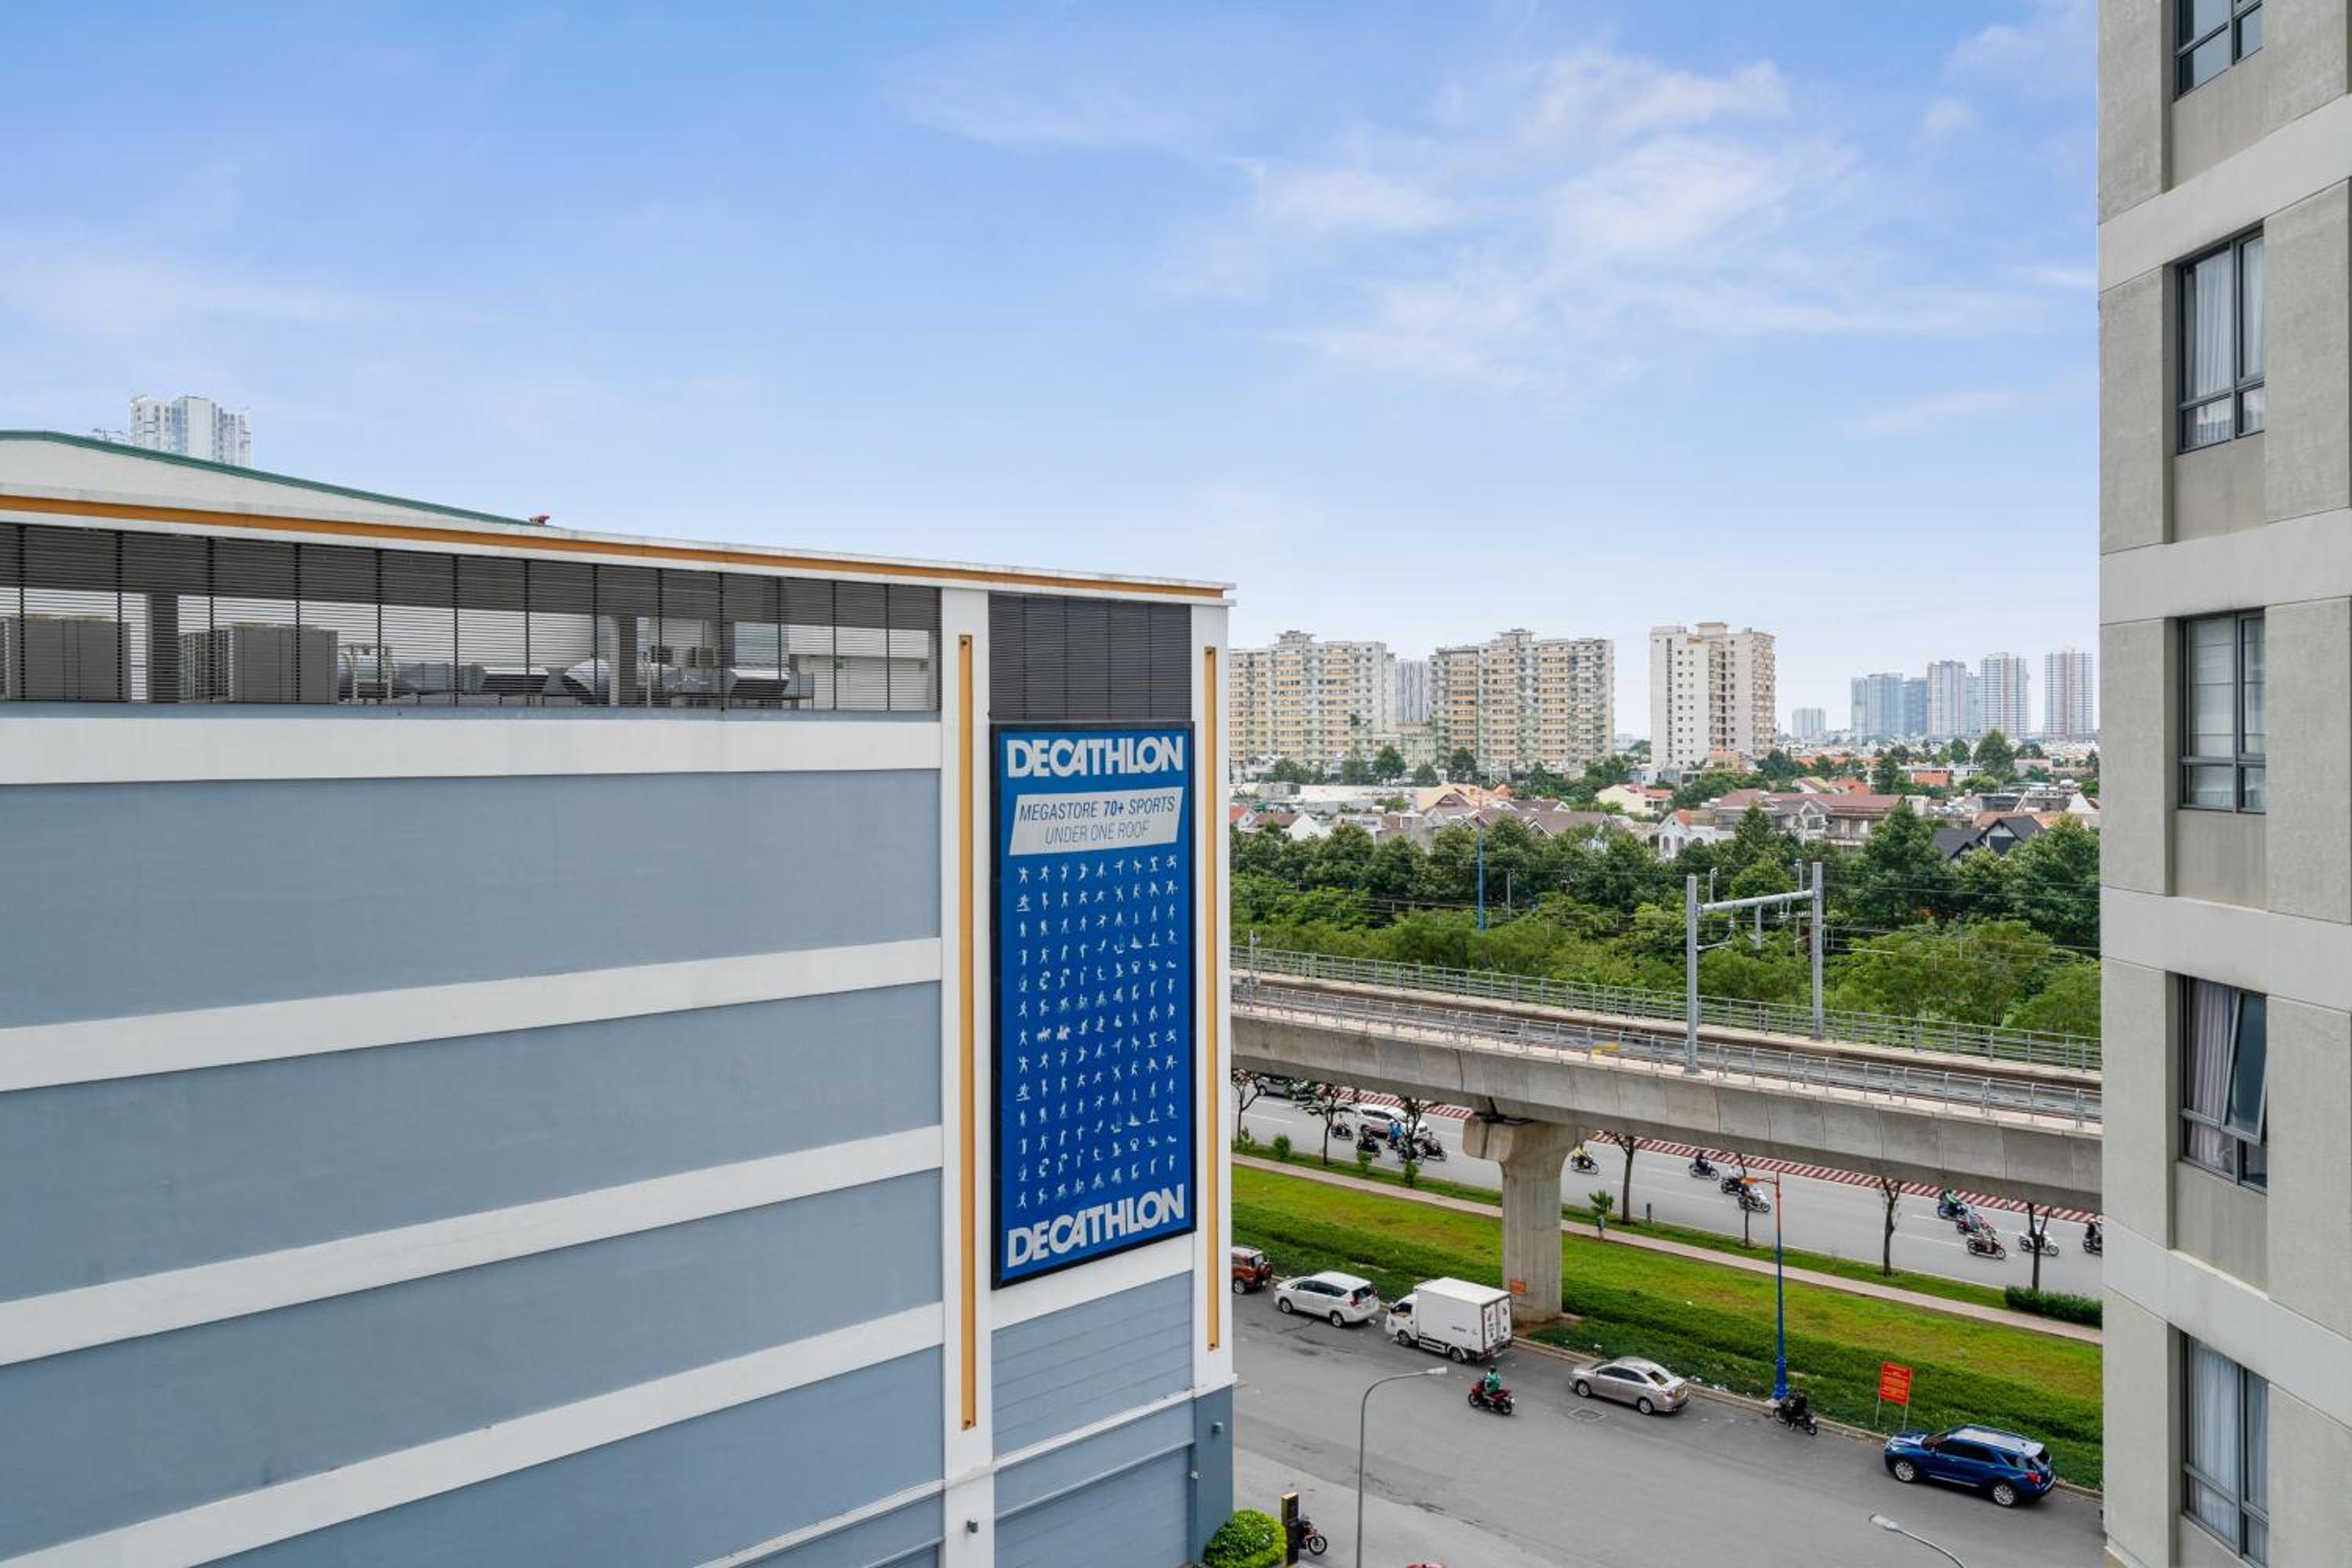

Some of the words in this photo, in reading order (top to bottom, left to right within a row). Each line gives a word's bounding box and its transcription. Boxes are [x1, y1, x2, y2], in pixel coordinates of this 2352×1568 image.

[1007, 736, 1184, 778] DECATHLON
[1019, 800, 1098, 822] MEGASTORE
[1103, 800, 1124, 817] 70+
[1128, 796, 1175, 814] SPORTS
[1045, 825, 1087, 844] UNDER
[1091, 822, 1114, 840] ONE
[1117, 820, 1149, 839] ROOF
[1007, 1184, 1185, 1268] DECATHLON
